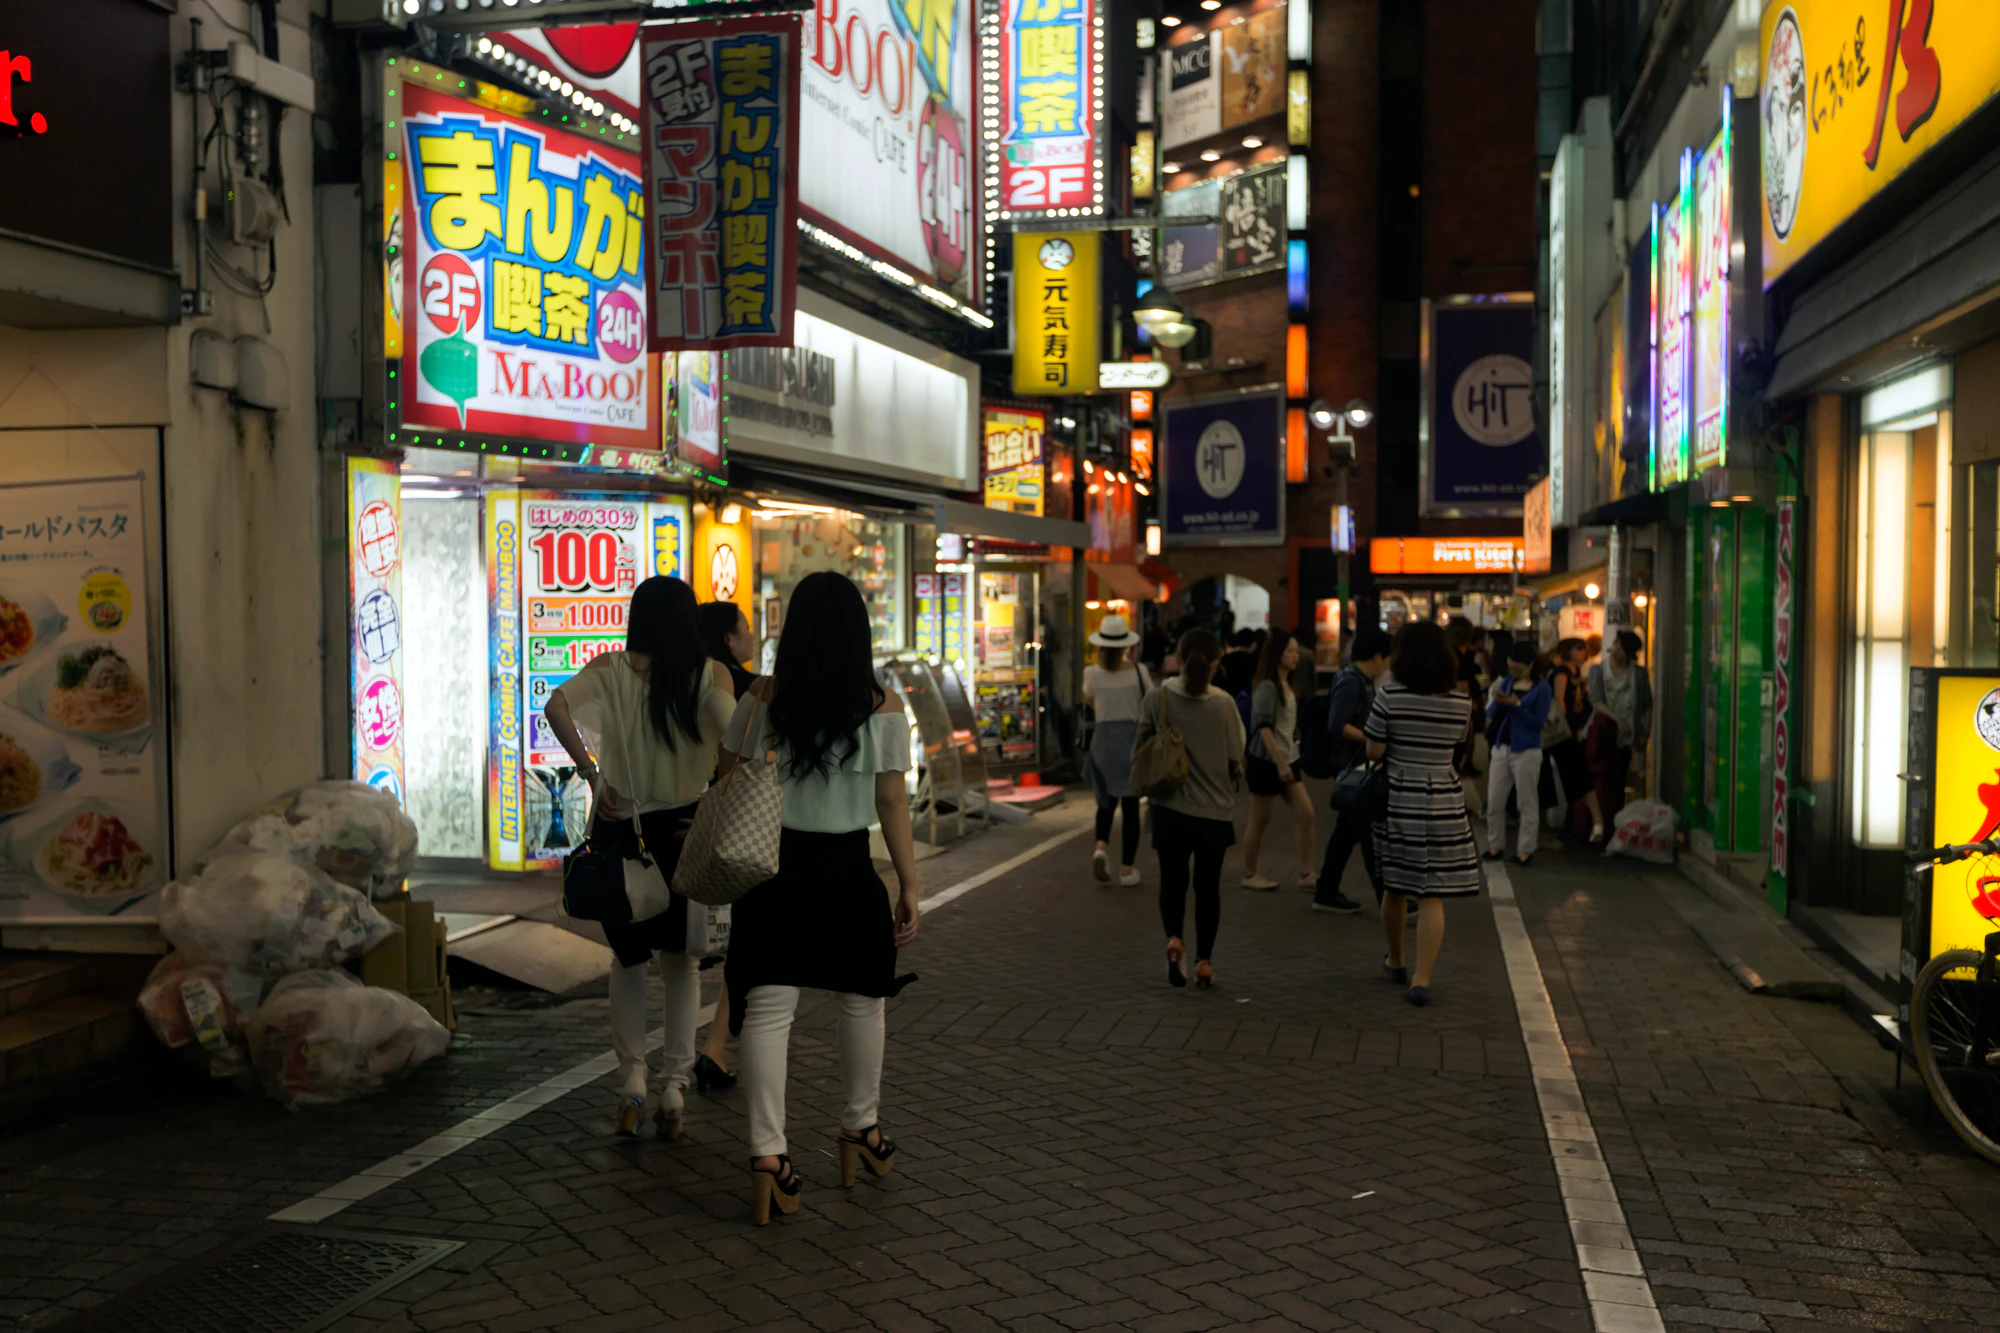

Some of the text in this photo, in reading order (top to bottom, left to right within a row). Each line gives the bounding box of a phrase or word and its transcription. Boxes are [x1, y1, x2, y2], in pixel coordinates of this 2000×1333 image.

[648, 39, 709, 97] 2F
[661, 82, 713, 122] 受付
[418, 131, 645, 281] まんが
[720, 42, 773, 328] まんが喫茶
[921, 122, 966, 252] 24H
[1009, 167, 1085, 207] 2F
[659, 125, 721, 336] マンボー
[424, 268, 478, 319] 2F
[493, 258, 590, 346] 喫茶
[600, 305, 643, 350] 24H
[1044, 278, 1069, 387] 元気寿司
[987, 428, 1041, 471] 出会い
[531, 507, 636, 526] はじめの30分
[532, 532, 618, 587] 100
[1433, 548, 1472, 562] First
[567, 603, 624, 627] 1,000
[498, 520, 519, 842] INTERNET COMIC CAFE MANBOO
[1771, 502, 1793, 878] KARAOKE
